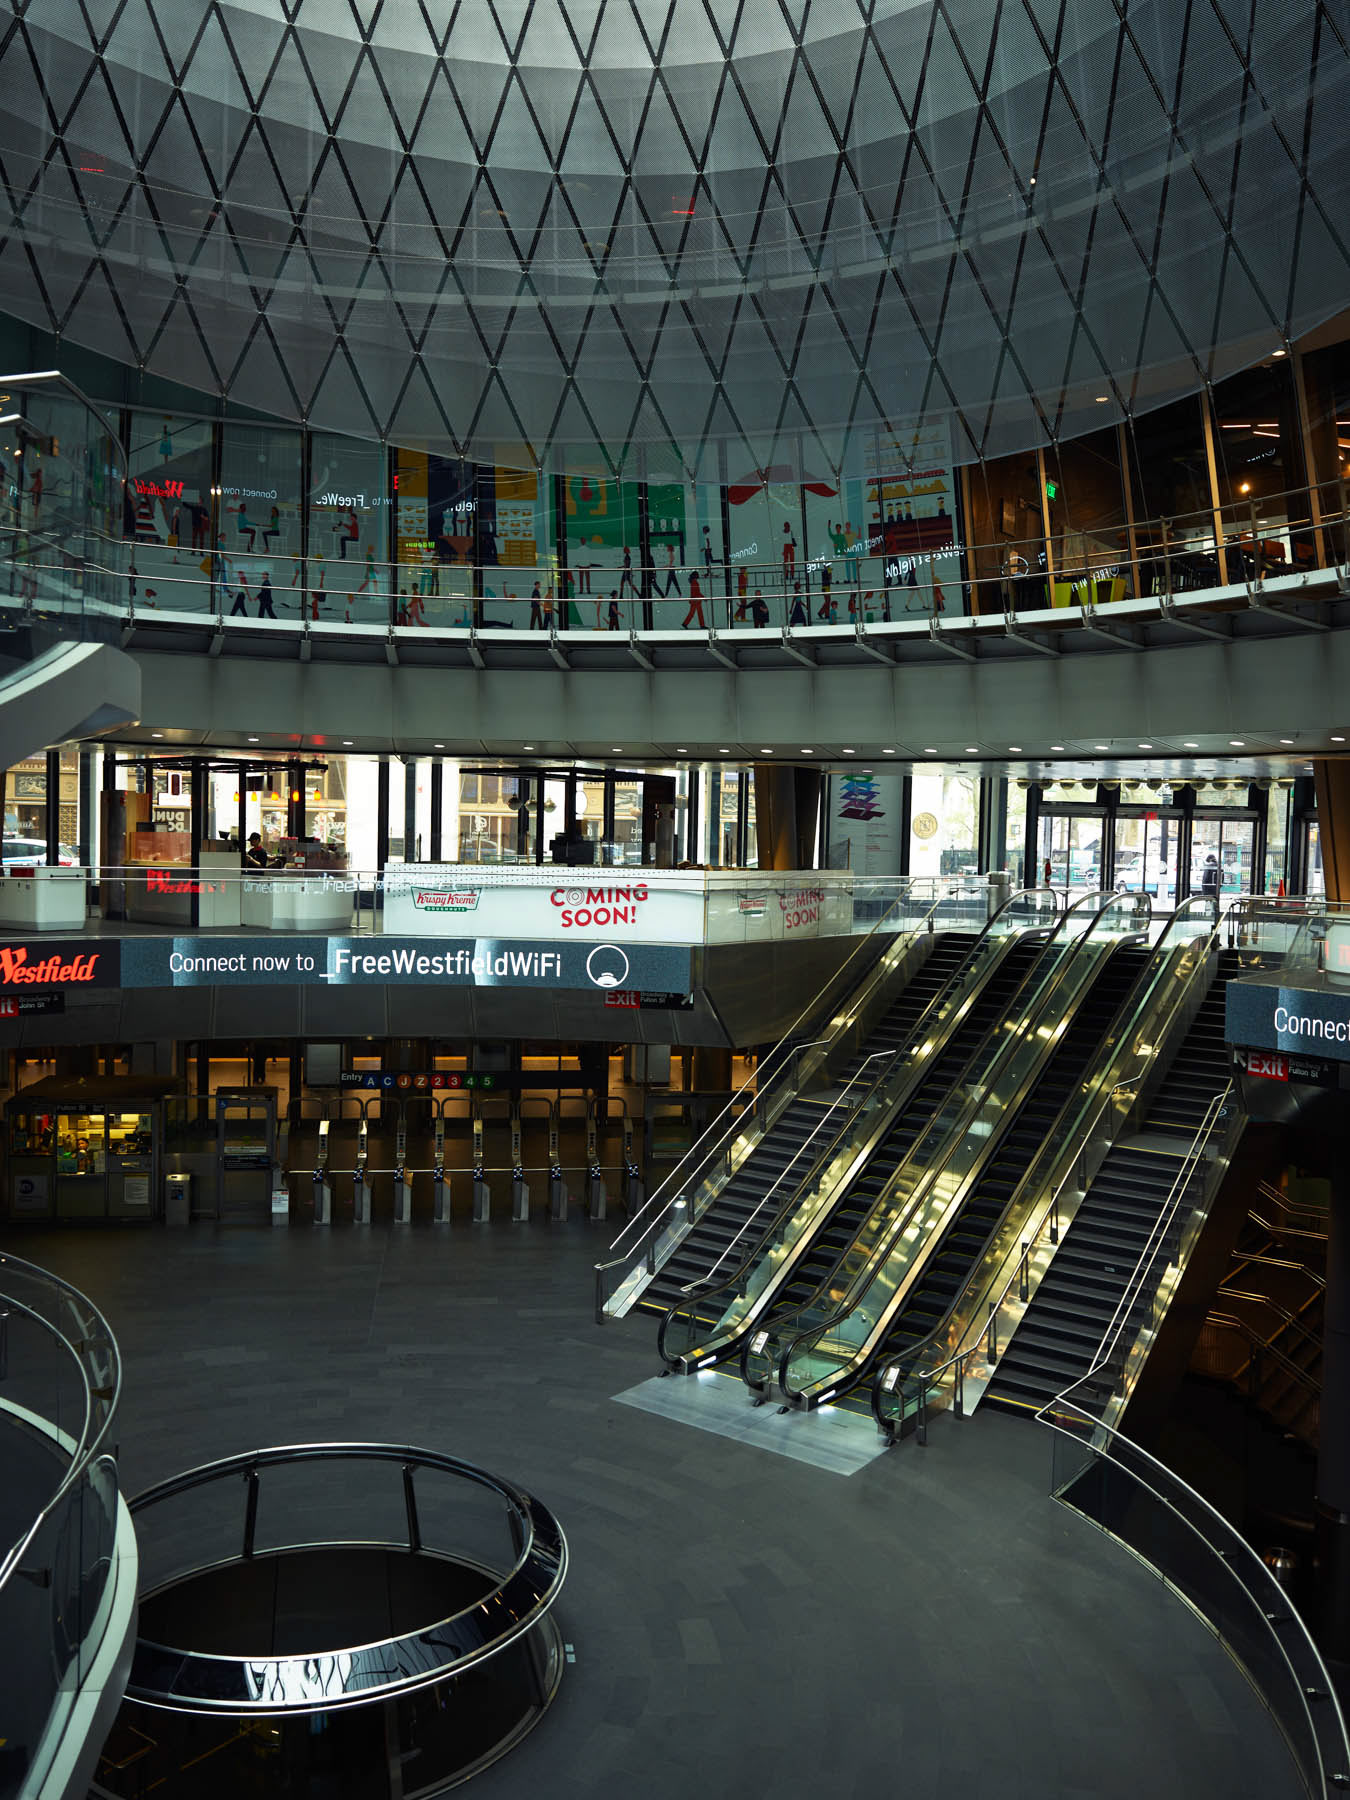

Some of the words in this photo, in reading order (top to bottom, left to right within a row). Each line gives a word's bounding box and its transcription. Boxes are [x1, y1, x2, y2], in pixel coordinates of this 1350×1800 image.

[416, 892, 448, 907] Krispy
[446, 892, 477, 905] Kreme
[551, 883, 649, 910] COMING
[559, 908, 636, 929] SOON!
[0, 948, 100, 985] Westfield
[169, 952, 247, 973] Connect
[253, 956, 290, 971] now
[296, 953, 314, 971] to
[604, 990, 637, 1006] Exit
[1247, 1051, 1284, 1078] Exit
[341, 1073, 363, 1083] Entry
